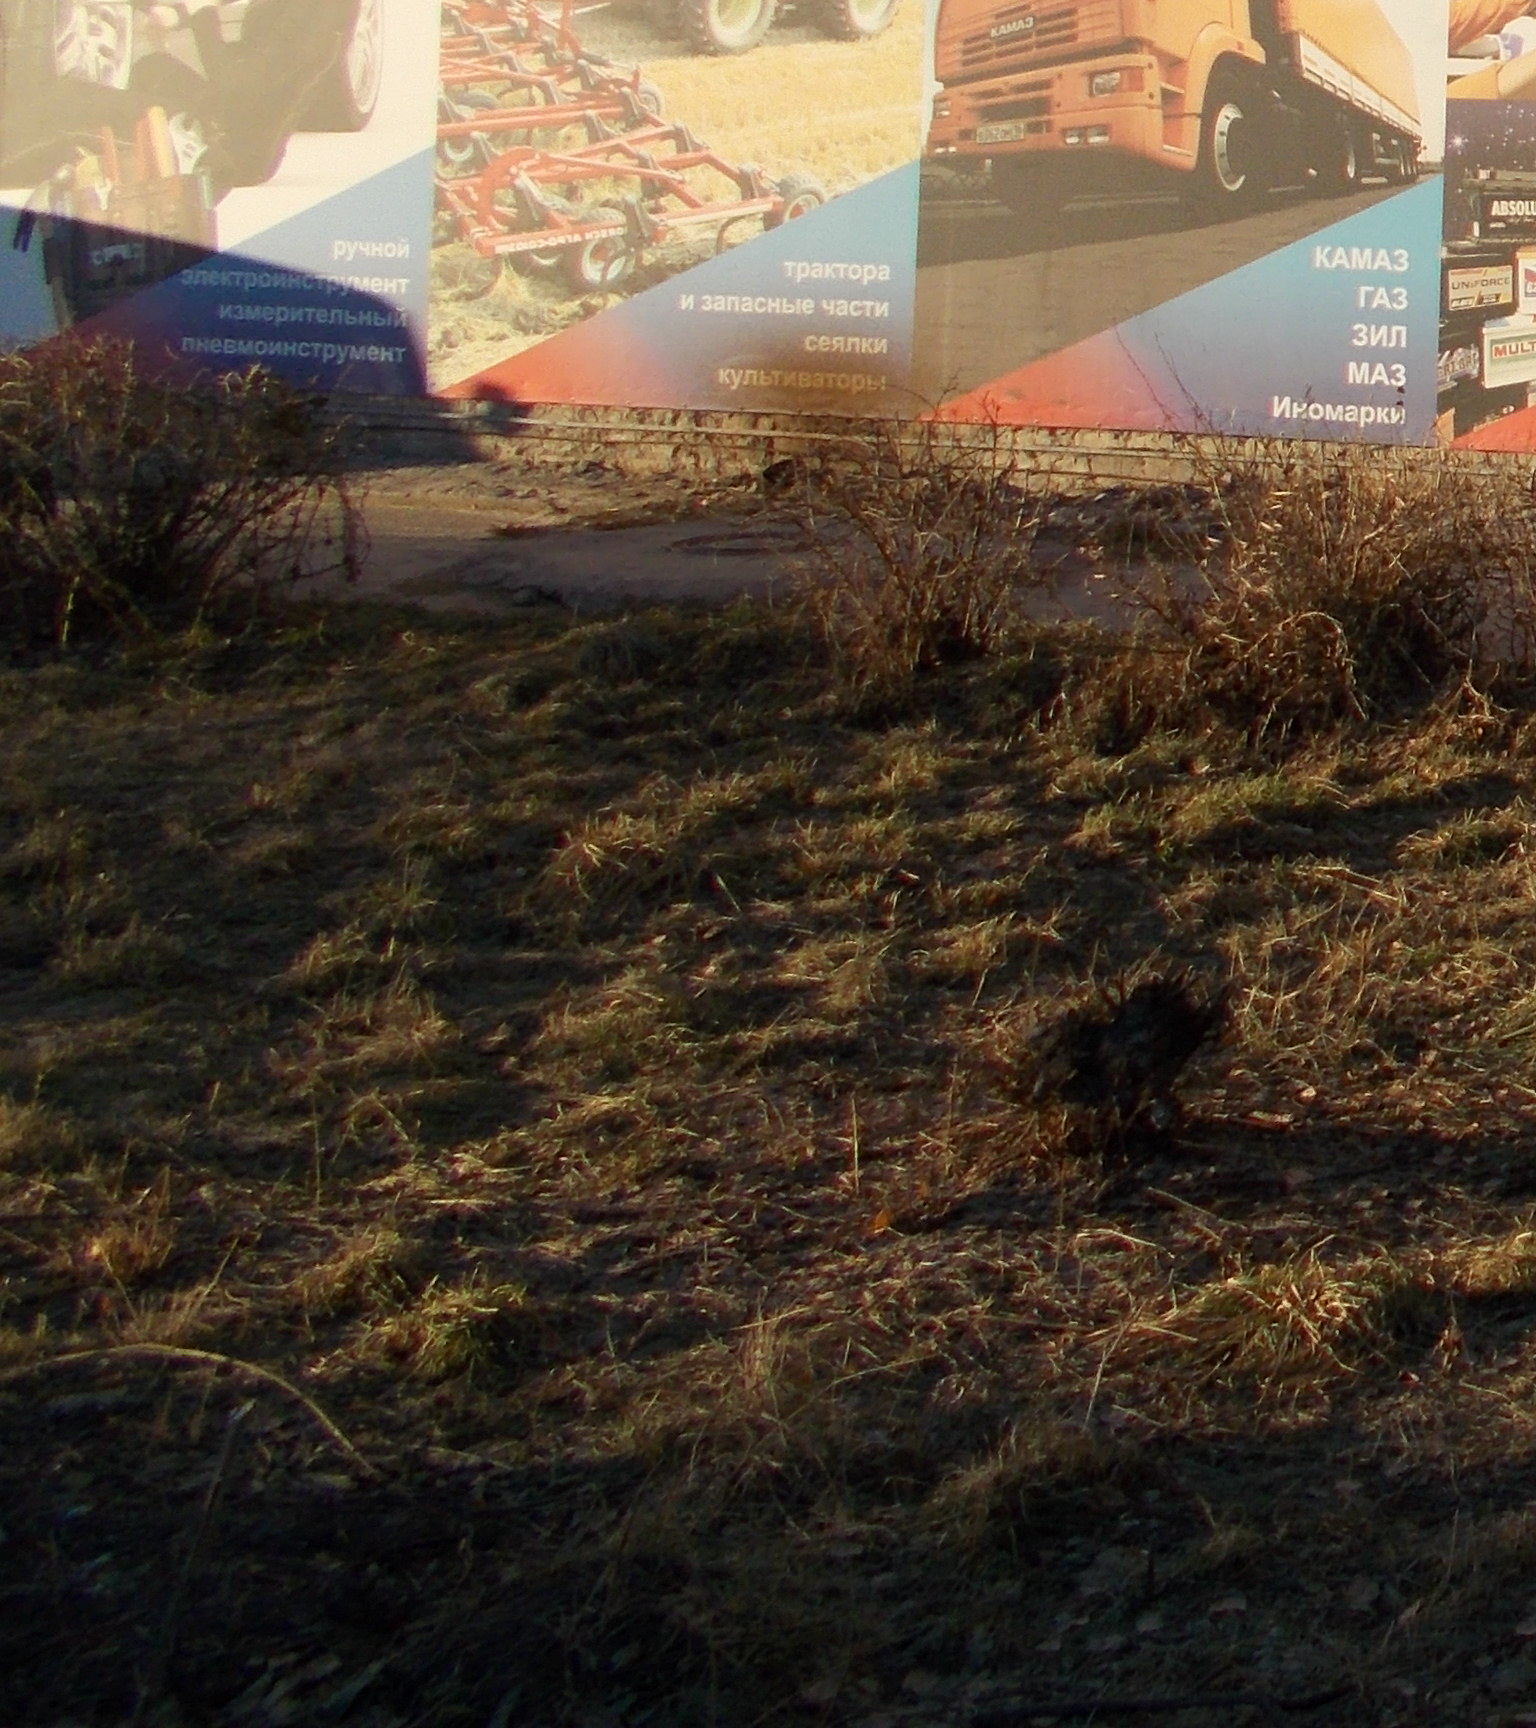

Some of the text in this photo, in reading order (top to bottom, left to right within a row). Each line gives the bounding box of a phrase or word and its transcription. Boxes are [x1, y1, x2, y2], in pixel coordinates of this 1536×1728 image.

[334, 238, 410, 261] ручной
[1315, 246, 1409, 272] КАМАЗ
[182, 268, 410, 296] электроинструмент
[784, 260, 891, 285] трактора
[680, 292, 889, 318] и запасные части
[1357, 286, 1408, 310] ГАЗ
[219, 303, 408, 329] измерительный
[804, 332, 888, 354] сеялки
[1352, 323, 1407, 348] ЗИЛ
[182, 334, 407, 364] пневмоинструмент
[718, 366, 888, 393] культиваторы
[1347, 361, 1406, 387] МАЗ
[1272, 395, 1406, 428] Иномарки
